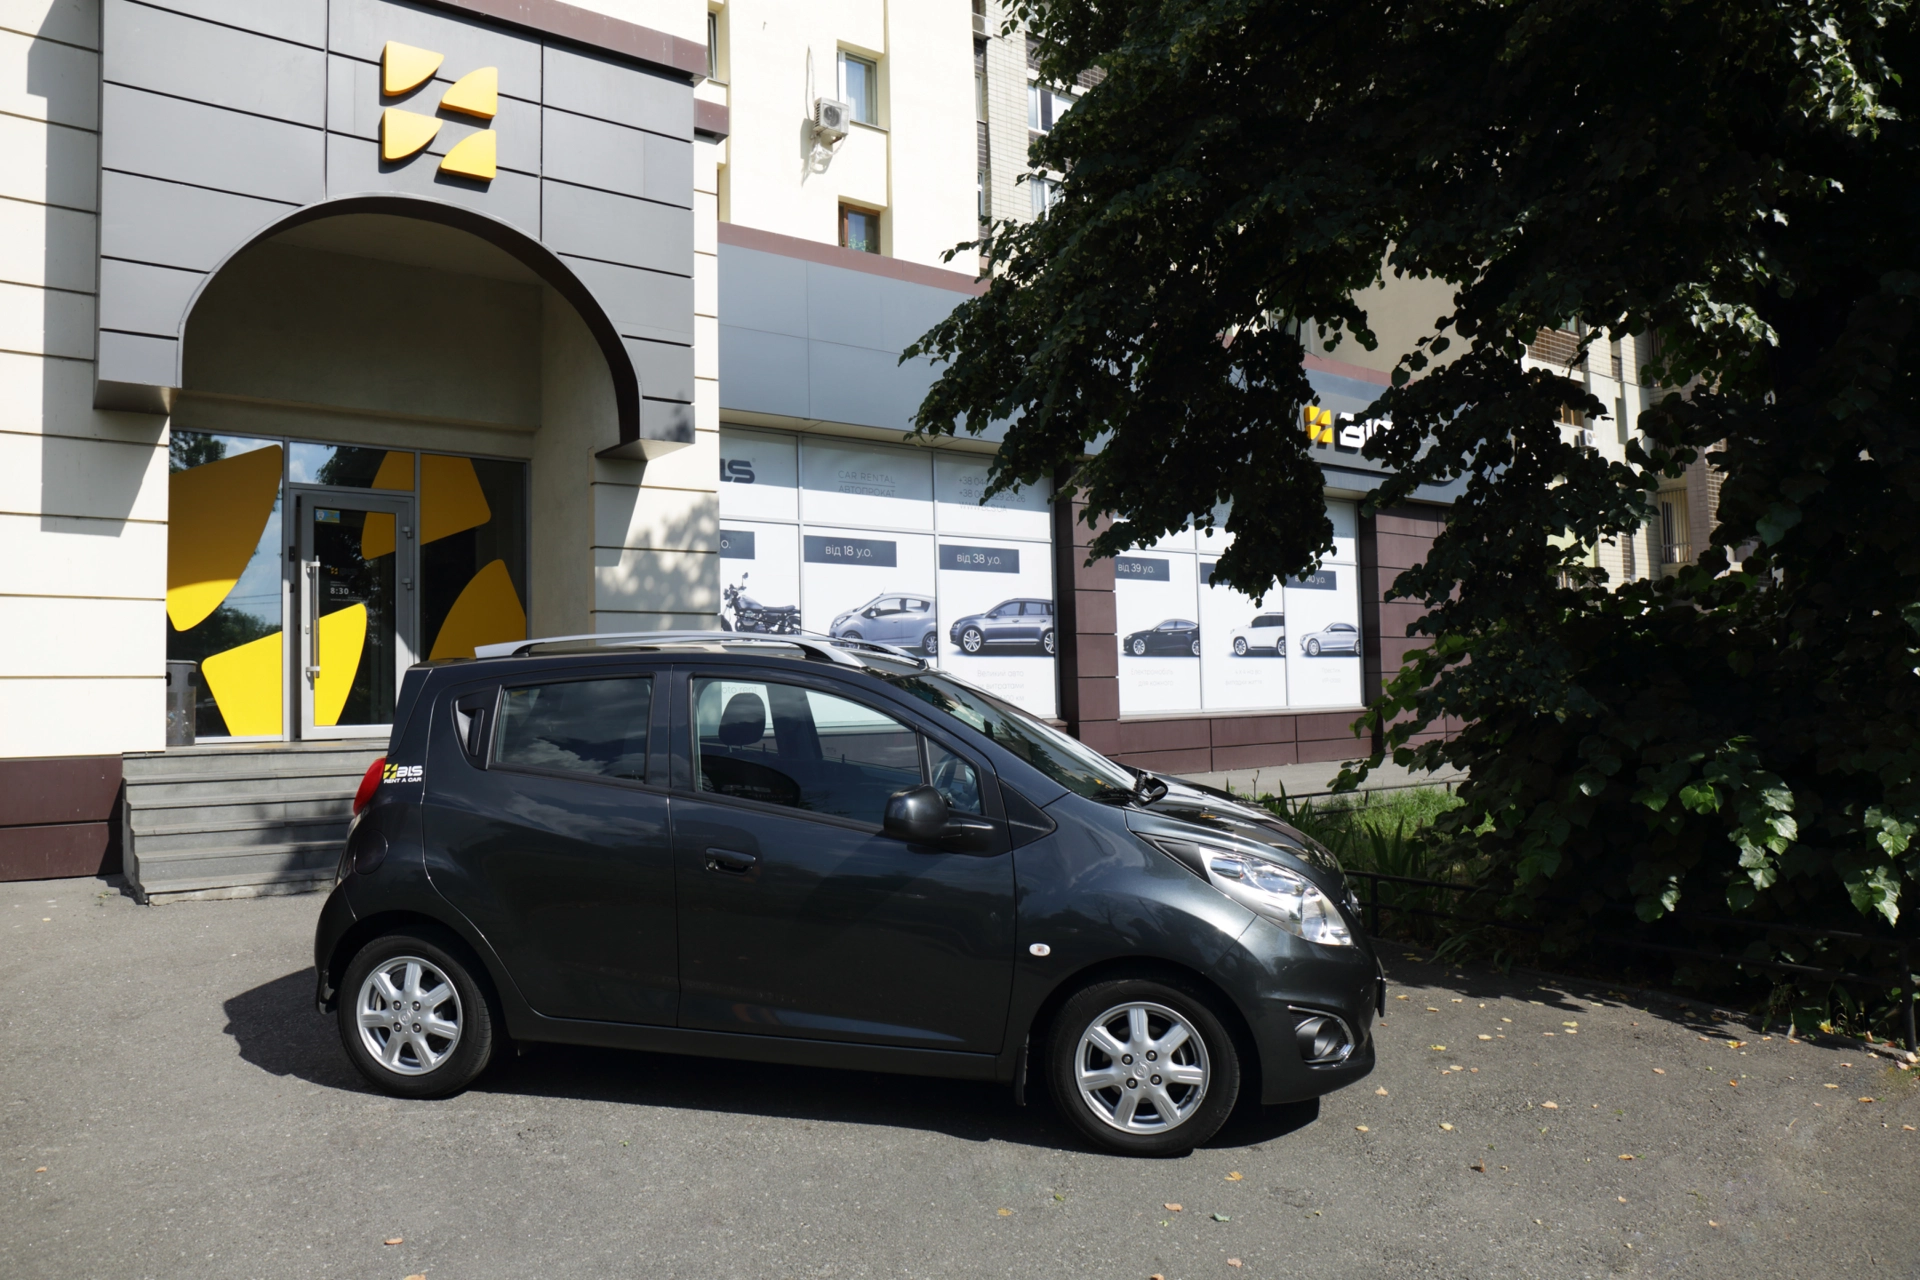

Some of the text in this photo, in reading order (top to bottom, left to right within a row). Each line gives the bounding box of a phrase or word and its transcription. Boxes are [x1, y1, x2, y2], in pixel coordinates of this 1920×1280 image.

[838, 470, 896, 485] CAR RENTAL
[825, 544, 842, 558] від
[843, 545, 854, 557] 18
[956, 552, 971, 565] від
[972, 553, 985, 564] 38
[1117, 562, 1130, 574] від
[1130, 563, 1142, 573] 39
[330, 586, 349, 596] 8:30
